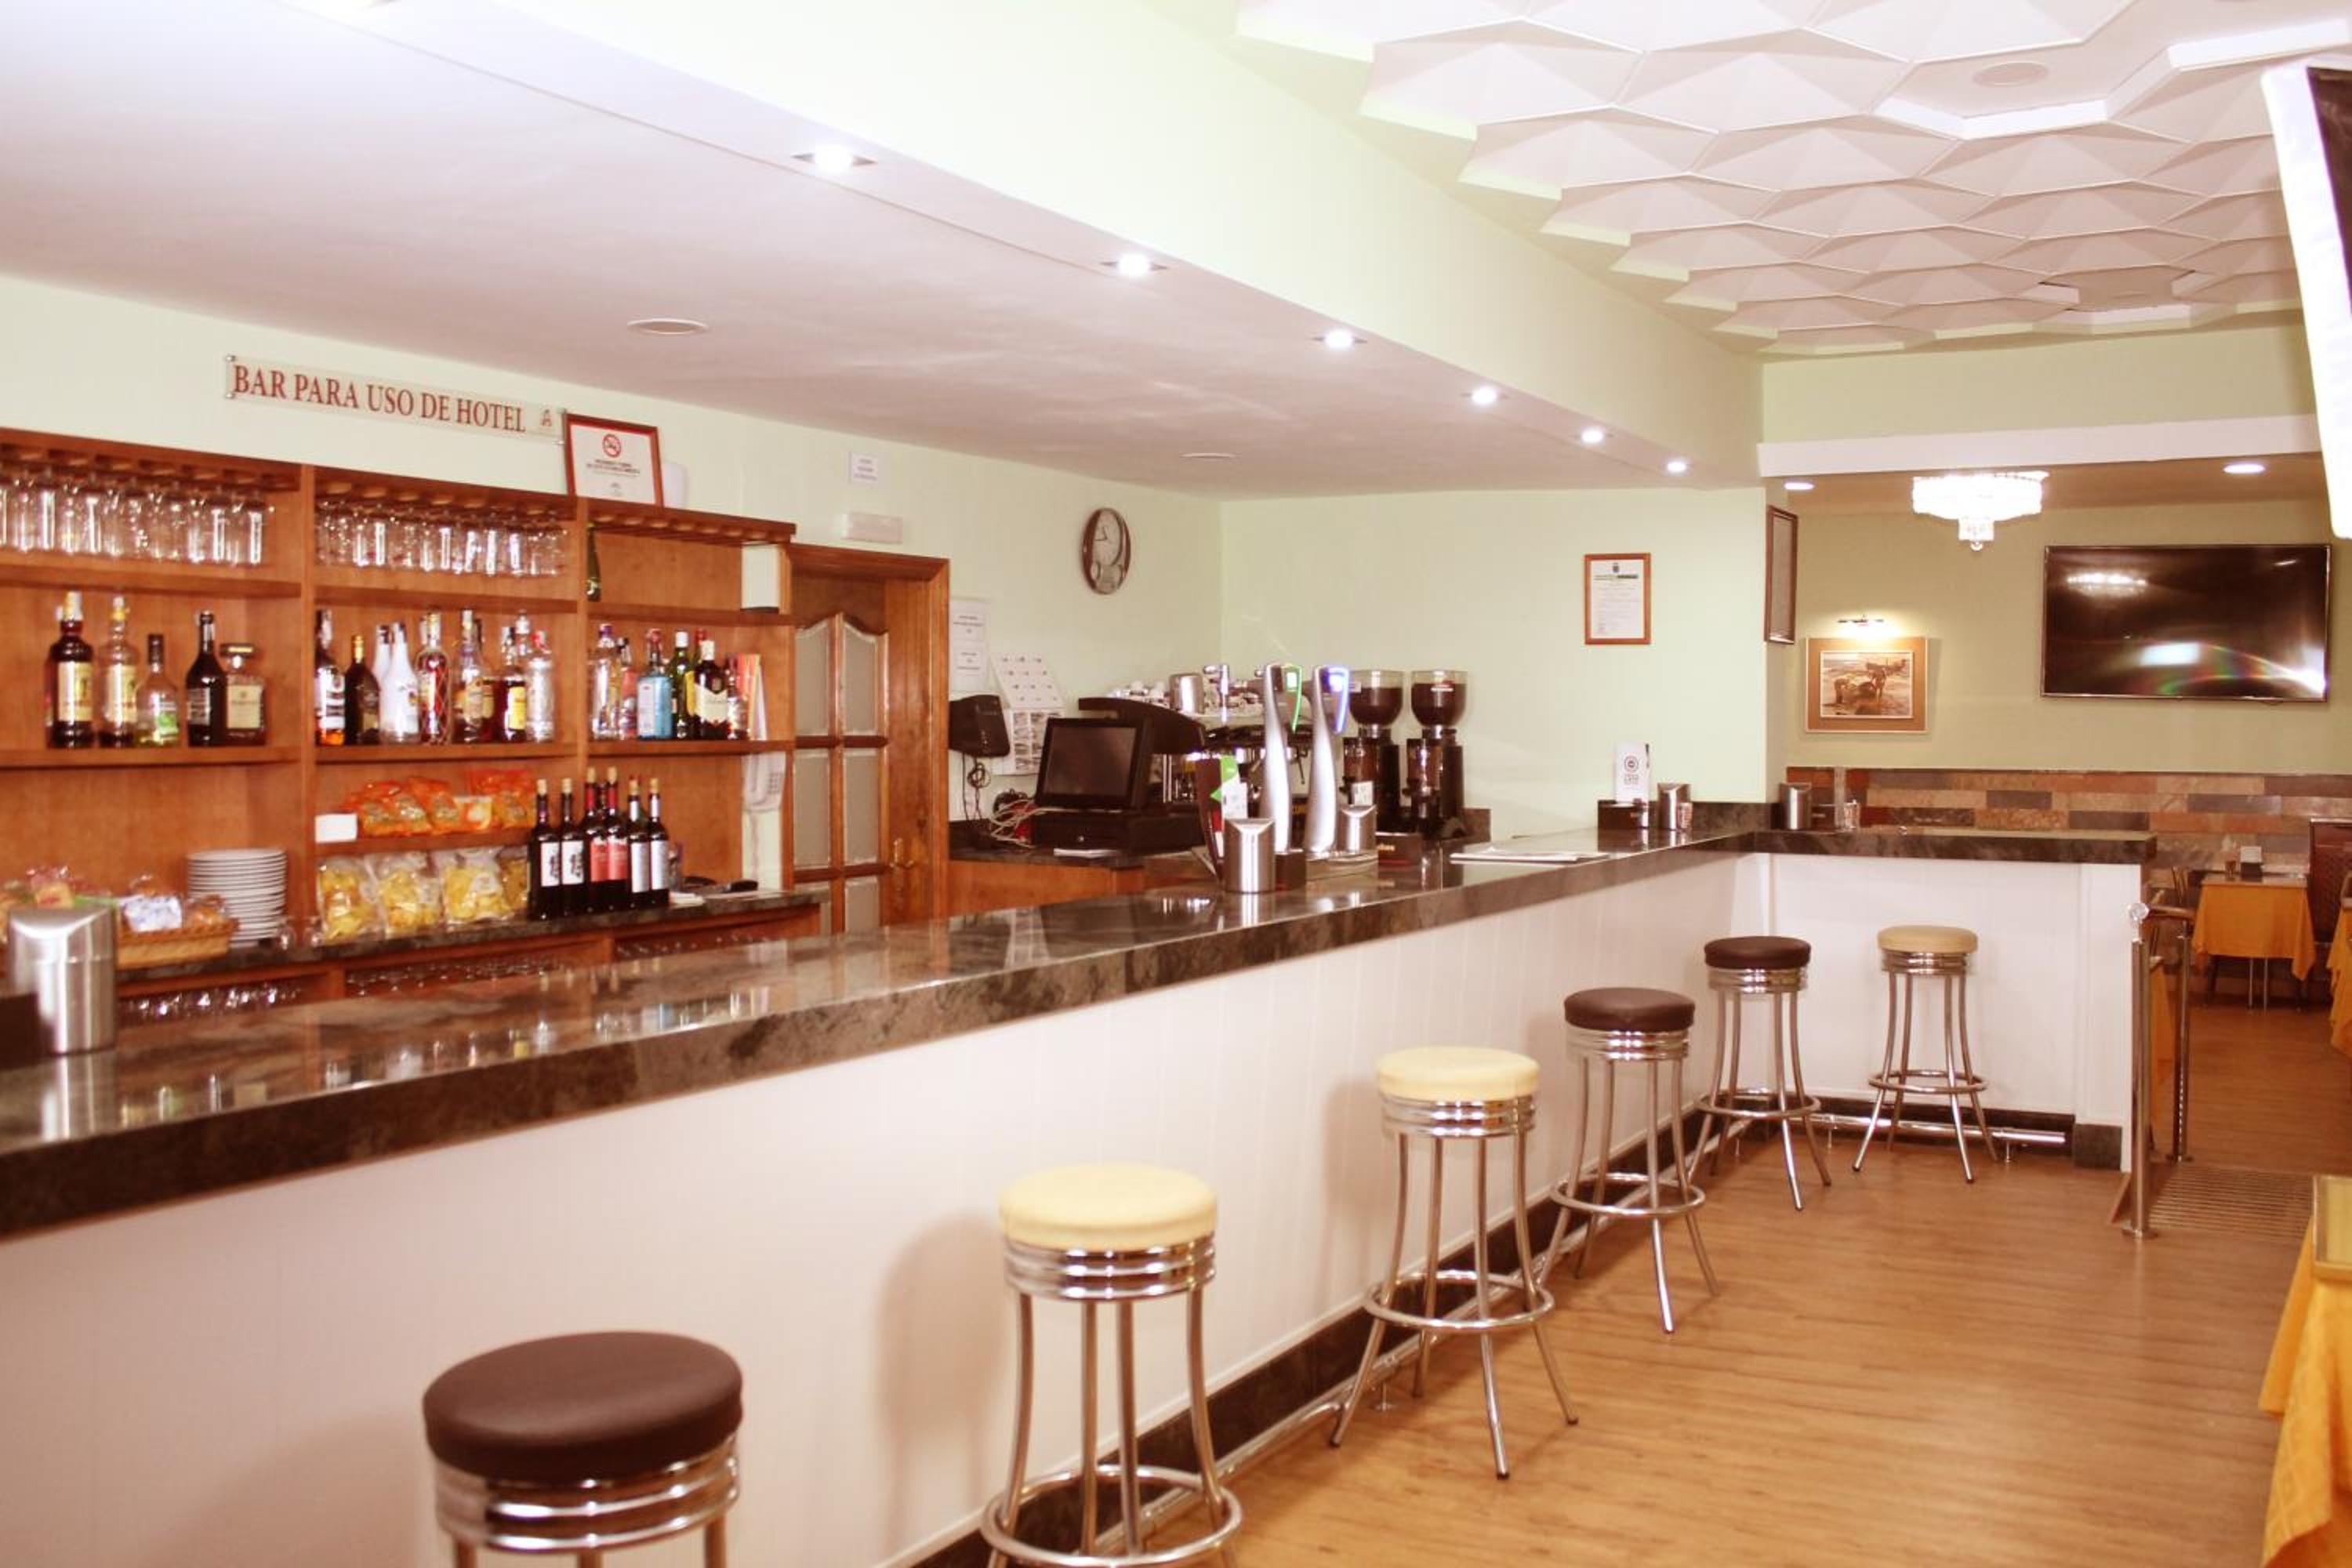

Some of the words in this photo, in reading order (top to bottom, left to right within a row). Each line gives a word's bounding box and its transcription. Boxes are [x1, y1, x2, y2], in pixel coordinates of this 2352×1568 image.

[234, 365, 287, 399] BAR
[294, 374, 359, 408] PARA
[366, 384, 414, 416] USO
[421, 392, 451, 421] DE
[457, 397, 526, 432] HOTEL
